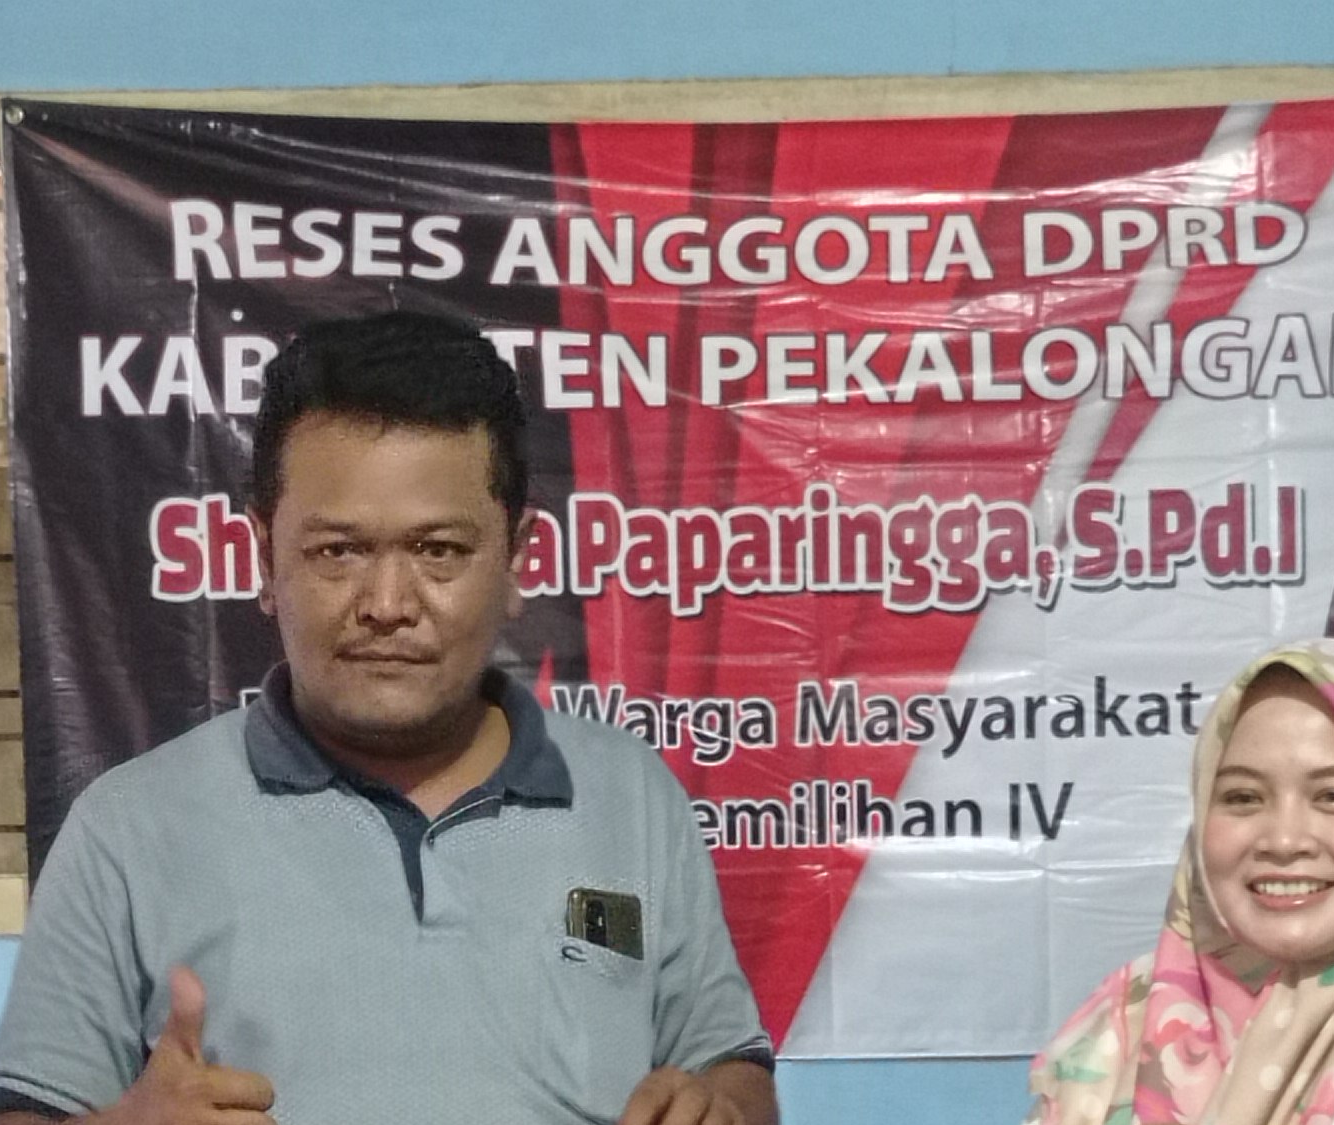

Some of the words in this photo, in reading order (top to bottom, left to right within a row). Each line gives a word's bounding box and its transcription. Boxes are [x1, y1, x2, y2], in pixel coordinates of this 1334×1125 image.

[170, 200, 465, 281] RESES
[489, 212, 993, 286] ANGGOTA
[1022, 202, 1309, 278] DPRD
[796, 675, 1204, 762] Masyarakat
[695, 781, 985, 850] emilihan
[1008, 782, 1075, 841] IV
